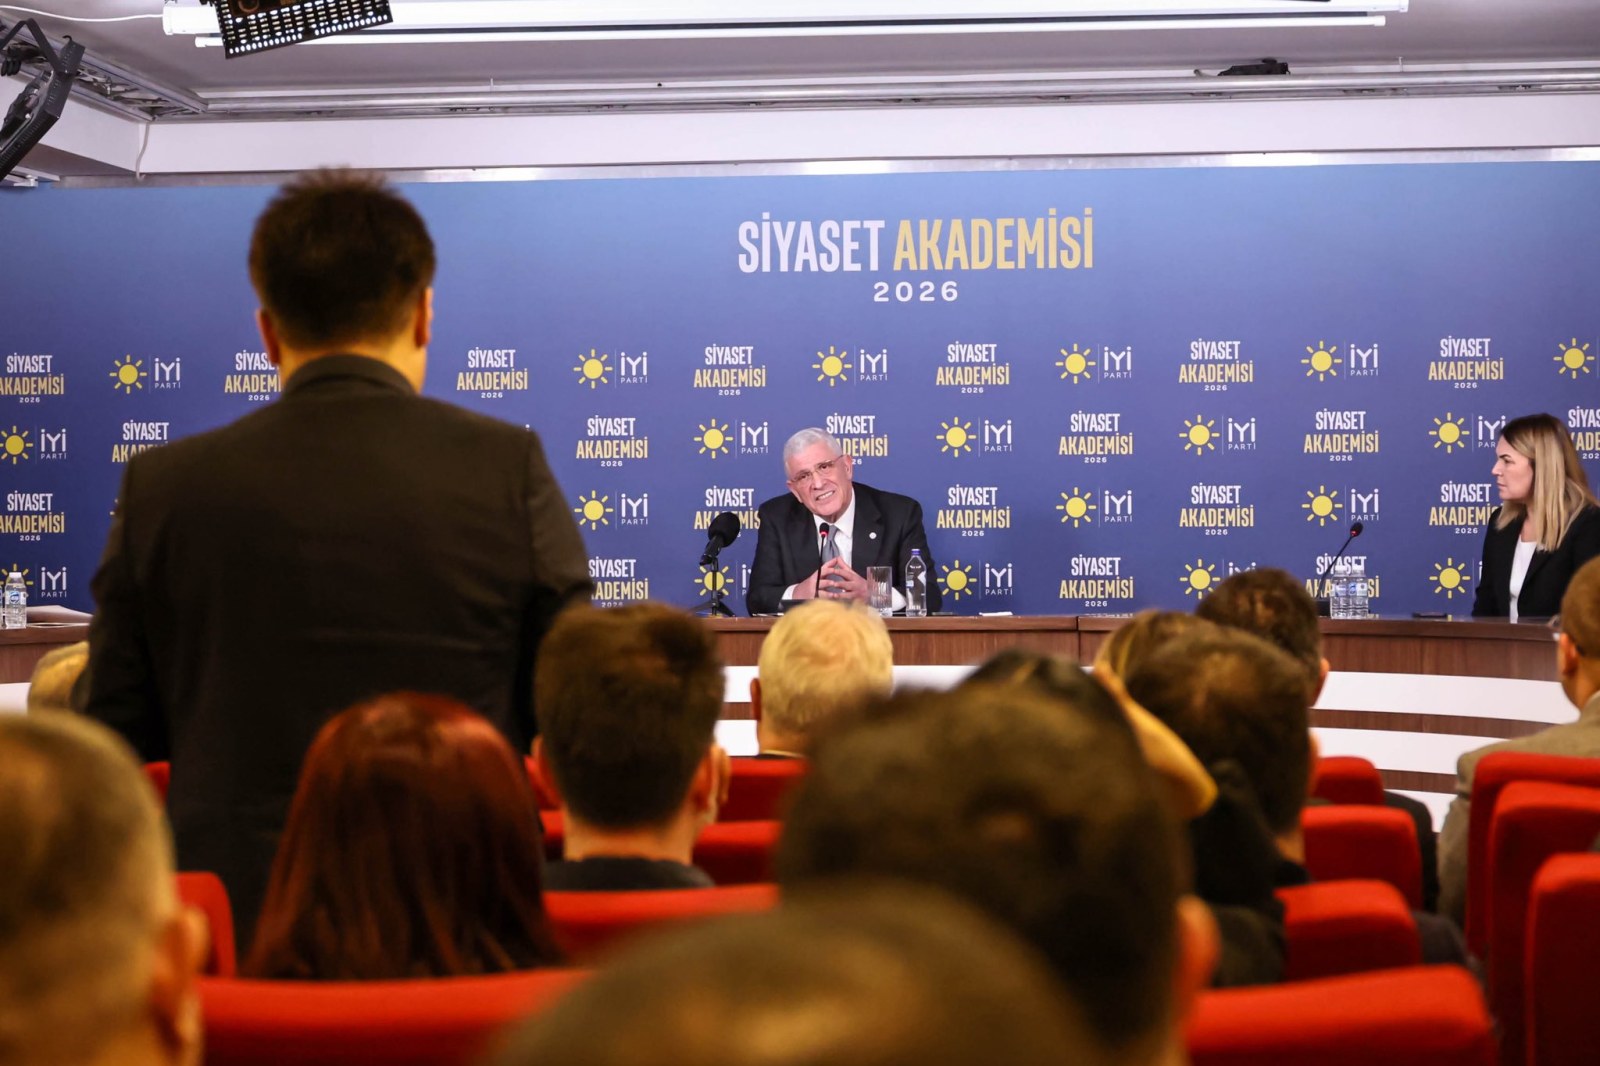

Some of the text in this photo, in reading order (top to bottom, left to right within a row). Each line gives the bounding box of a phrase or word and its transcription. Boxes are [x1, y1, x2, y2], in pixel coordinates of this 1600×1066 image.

[738, 207, 1093, 273] SİYASET AKADEMİSİ
[873, 281, 958, 302] 2026
[468, 347, 515, 368] SİYASET
[705, 343, 753, 365] SİYASET
[947, 341, 997, 363] SİYASET
[1190, 338, 1240, 360] SİYASET
[1350, 343, 1378, 369] İYİ
[1440, 336, 1491, 358] SİYASET
[6, 353, 52, 373] SİYASET
[155, 357, 181, 382] İYİ
[235, 349, 276, 371] SİYAS
[621, 352, 648, 376] İYİ
[860, 349, 888, 374] İYİ
[1104, 346, 1132, 371] İYİ
[1428, 358, 1504, 381] AKADEMİSİ
[457, 368, 528, 390] AKADEMİSİ
[693, 365, 766, 388] AKADEMİSİ
[936, 363, 1010, 386] AKADEMİSİ
[1179, 360, 1253, 383] AKADEMİSİ
[587, 415, 636, 436] SİYASET
[826, 412, 875, 435] SİYASET
[1070, 410, 1120, 432] SİYASET
[1315, 408, 1366, 430] SİYASET
[1568, 405, 1600, 428] SİYAS
[41, 428, 66, 452] İYİ
[122, 419, 169, 441] SİYASET
[741, 422, 769, 446] İYİ
[985, 420, 1012, 444] İYİ
[1228, 417, 1256, 442] İYİ
[576, 437, 648, 459] AKADEMİSİ
[836, 434, 888, 457] DEMİSİ
[1059, 433, 1133, 455] AKADEMİSİ
[1304, 431, 1379, 453] AKADEMİSİ
[6, 490, 53, 511] SİYASET
[705, 485, 754, 507] SİYASET
[948, 484, 997, 506] SİYASET
[1105, 490, 1132, 515] İYİ
[1191, 482, 1241, 504] SİYASET
[1351, 488, 1379, 513] İYİ
[1440, 481, 1491, 503] SİYASET
[621, 493, 648, 517] İYİ
[1179, 505, 1254, 527] AKADEMİSİ
[1429, 503, 1498, 526] AKADEMİ
[936, 506, 1010, 529] AKADEMİSİ
[588, 556, 636, 578] SİYASET
[985, 563, 1012, 588] İYİ
[1071, 554, 1121, 576] SİYASET
[41, 566, 67, 591] İYİ
[591, 578, 649, 600] ADEMİSİ
[1059, 576, 1134, 599] AKADEMİSİ
